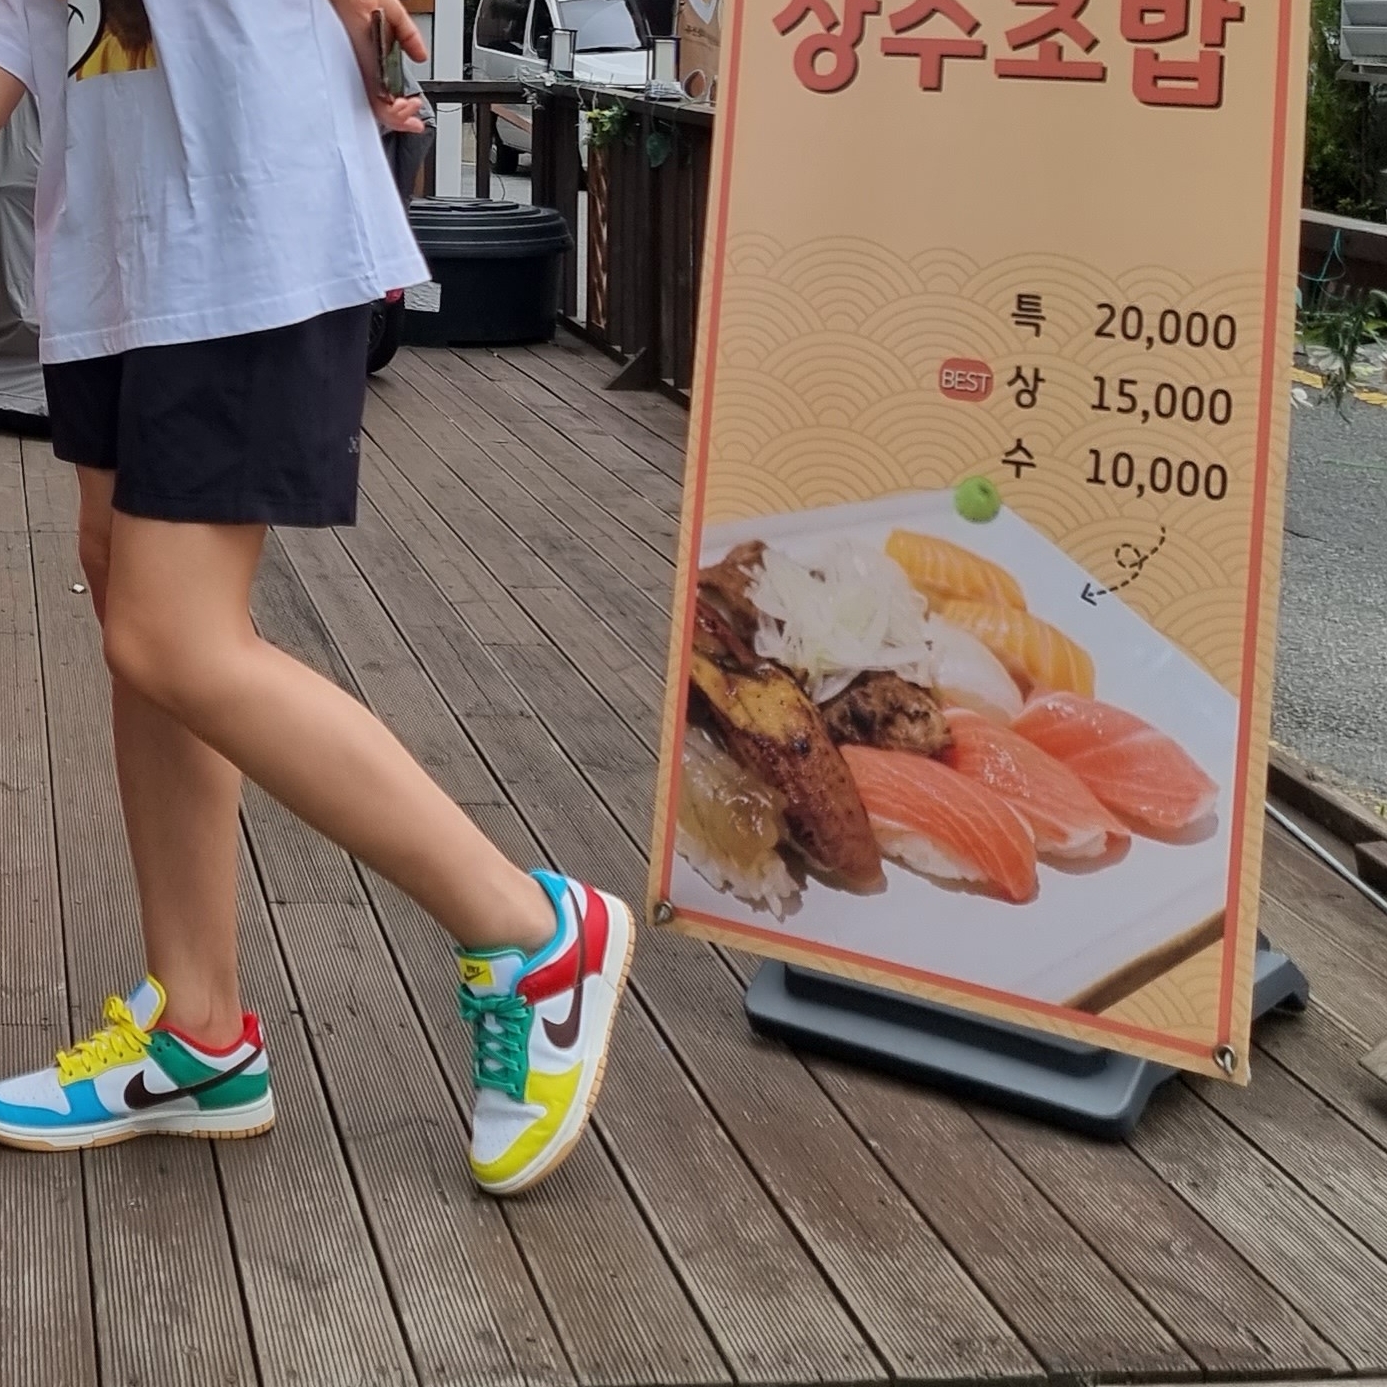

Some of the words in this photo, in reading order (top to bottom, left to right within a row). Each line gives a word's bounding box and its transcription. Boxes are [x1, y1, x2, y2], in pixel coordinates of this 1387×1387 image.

[1010, 293, 1046, 338] 특
[1094, 302, 1237, 351] 20,000
[940, 368, 992, 392] BEST
[1007, 366, 1046, 410] 상
[1090, 376, 1232, 426] 15,000
[1000, 438, 1037, 478] 수
[1085, 449, 1228, 501] 10,000
